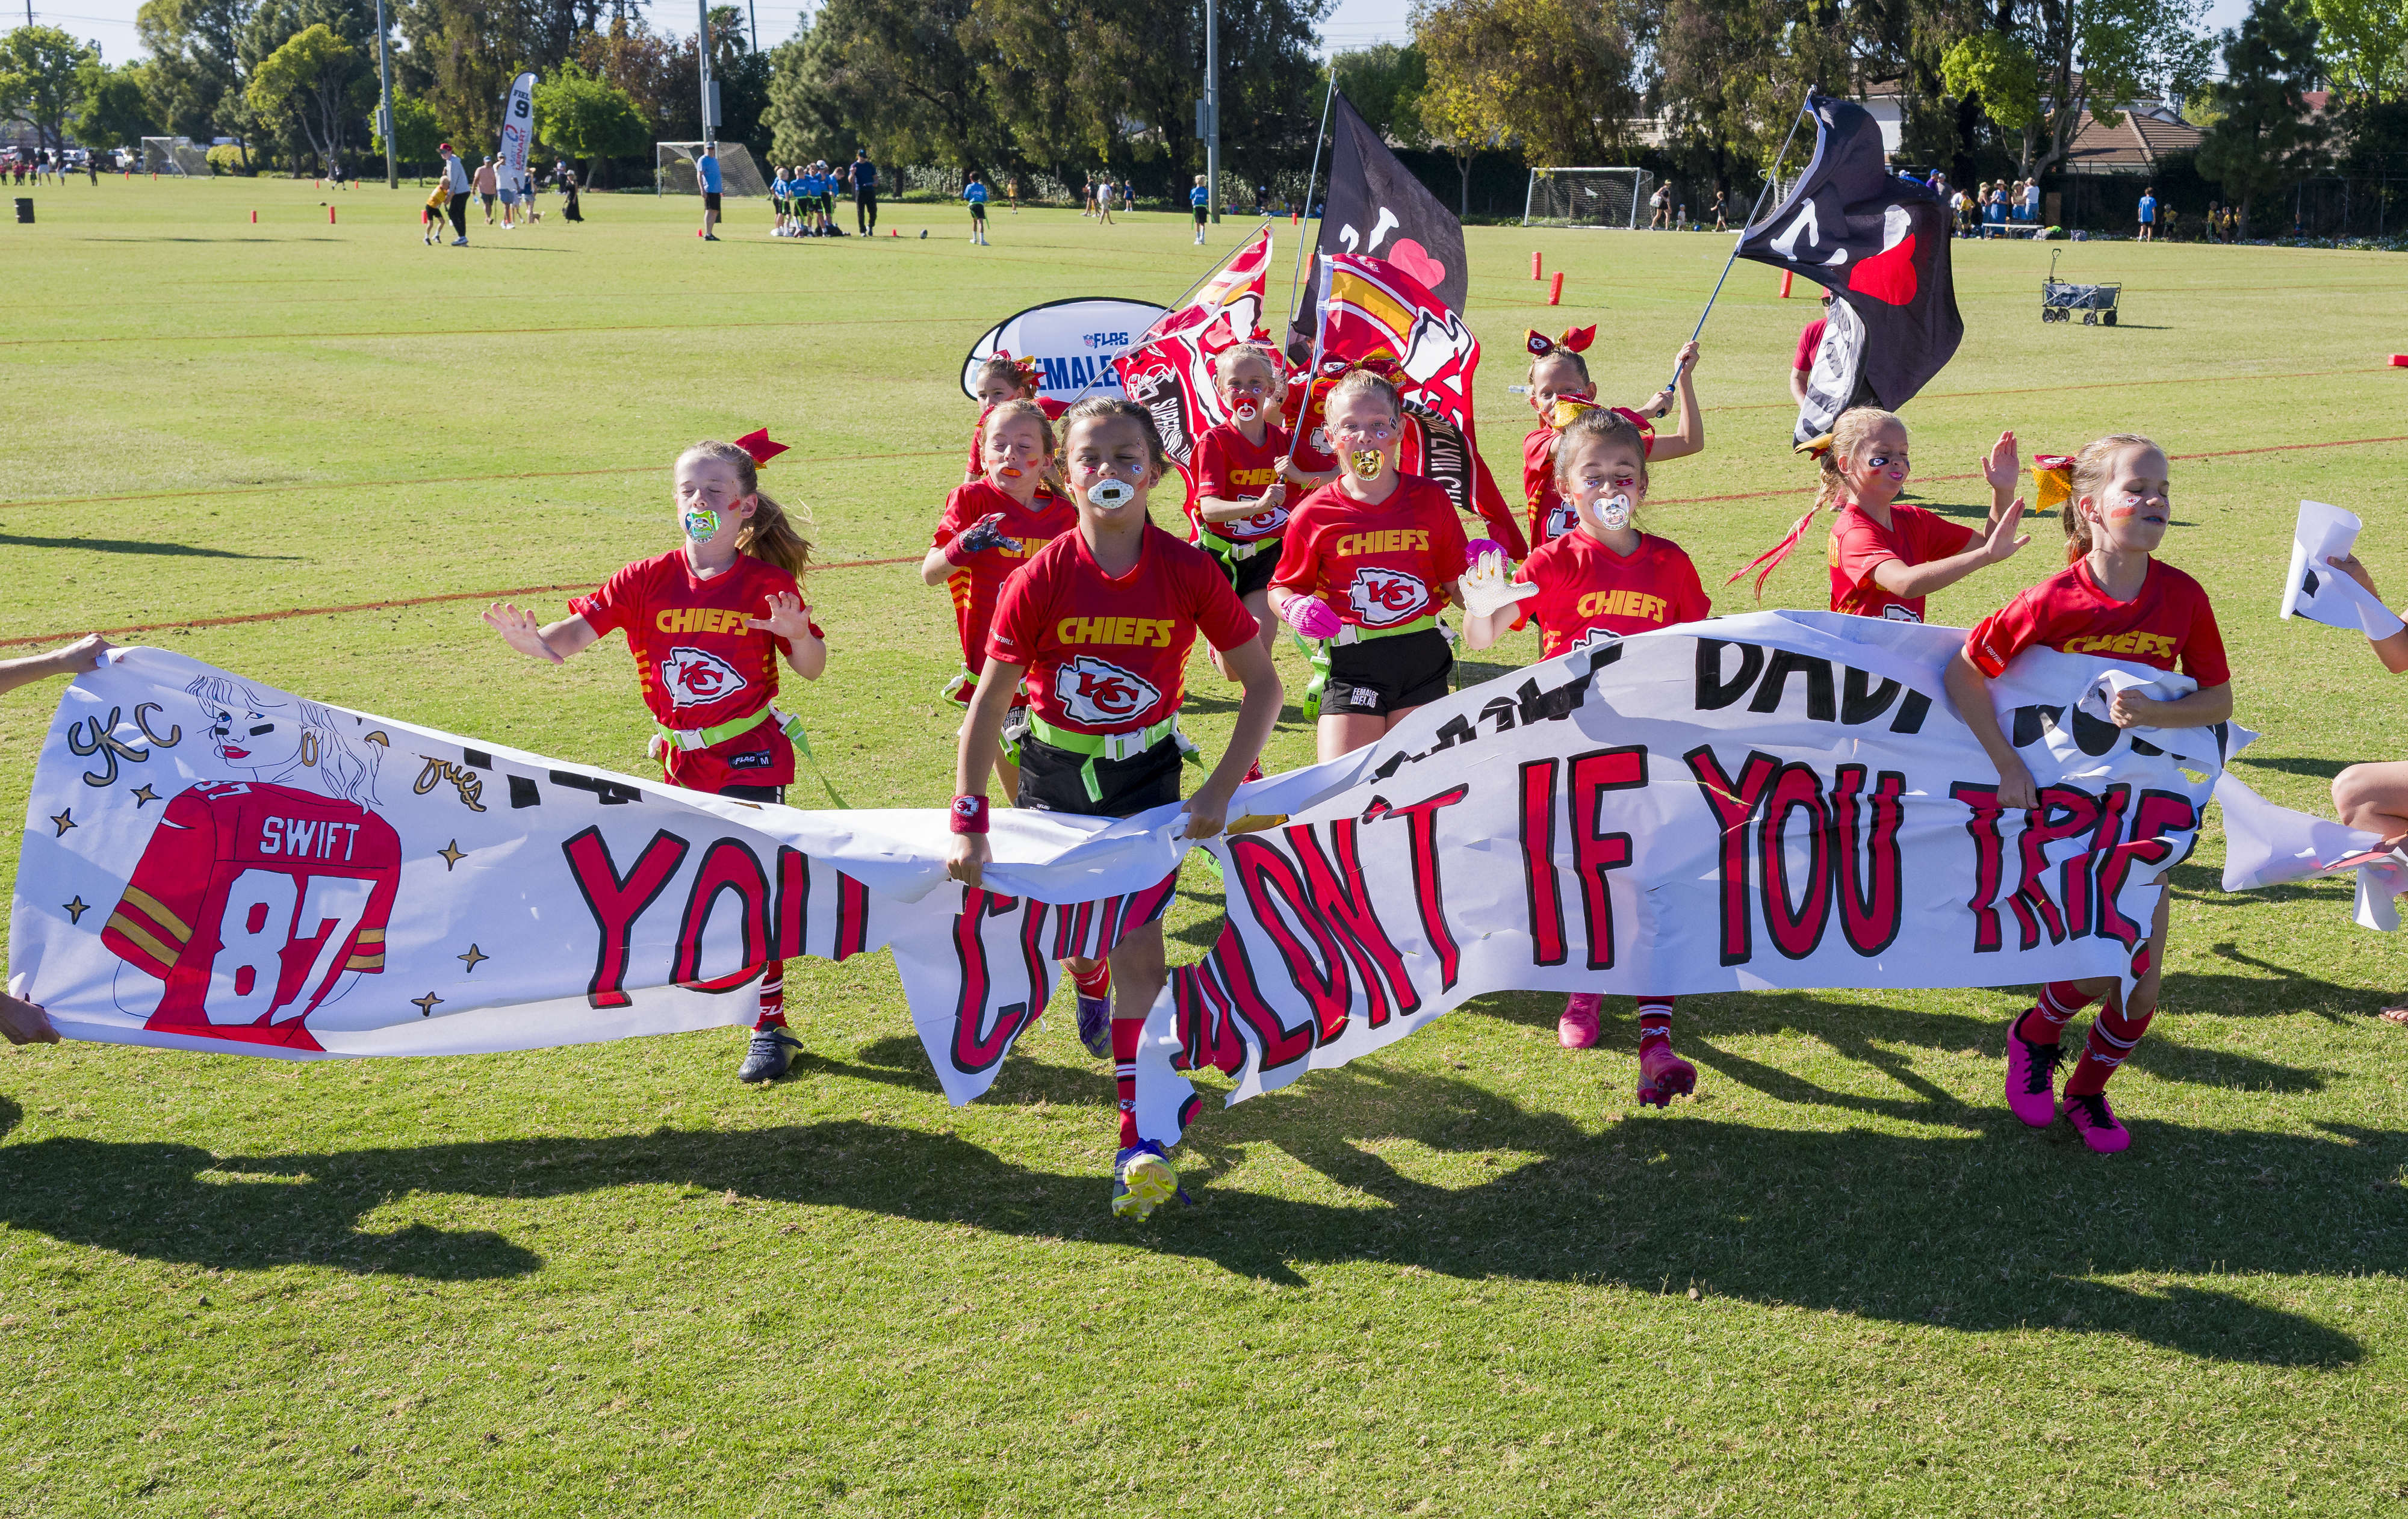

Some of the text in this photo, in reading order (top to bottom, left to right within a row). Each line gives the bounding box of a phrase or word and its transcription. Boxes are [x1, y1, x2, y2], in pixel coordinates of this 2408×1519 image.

[514, 99, 530, 119] 9
[515, 127, 527, 171] LEINART
[1093, 332, 1128, 348] FLAG
[1336, 529, 1429, 557] CHIEFS
[1366, 579, 1417, 611] KC
[1577, 589, 1668, 623] CHIEFS
[656, 608, 754, 636] CHIEFS
[1057, 616, 1176, 648] CHIEFS
[2062, 630, 2177, 658] CHIEFS
[677, 660, 724, 696] KC
[1353, 687, 1379, 699] FEMALES
[1075, 672, 1140, 715] KC
[1006, 710, 1026, 720] EMALES
[735, 755, 756, 766] FLAG
[760, 756, 769, 765] M
[259, 815, 361, 861] SWIFT
[1518, 744, 1649, 971] IF
[1683, 743, 1908, 967] YOU
[203, 867, 379, 1027] 87
